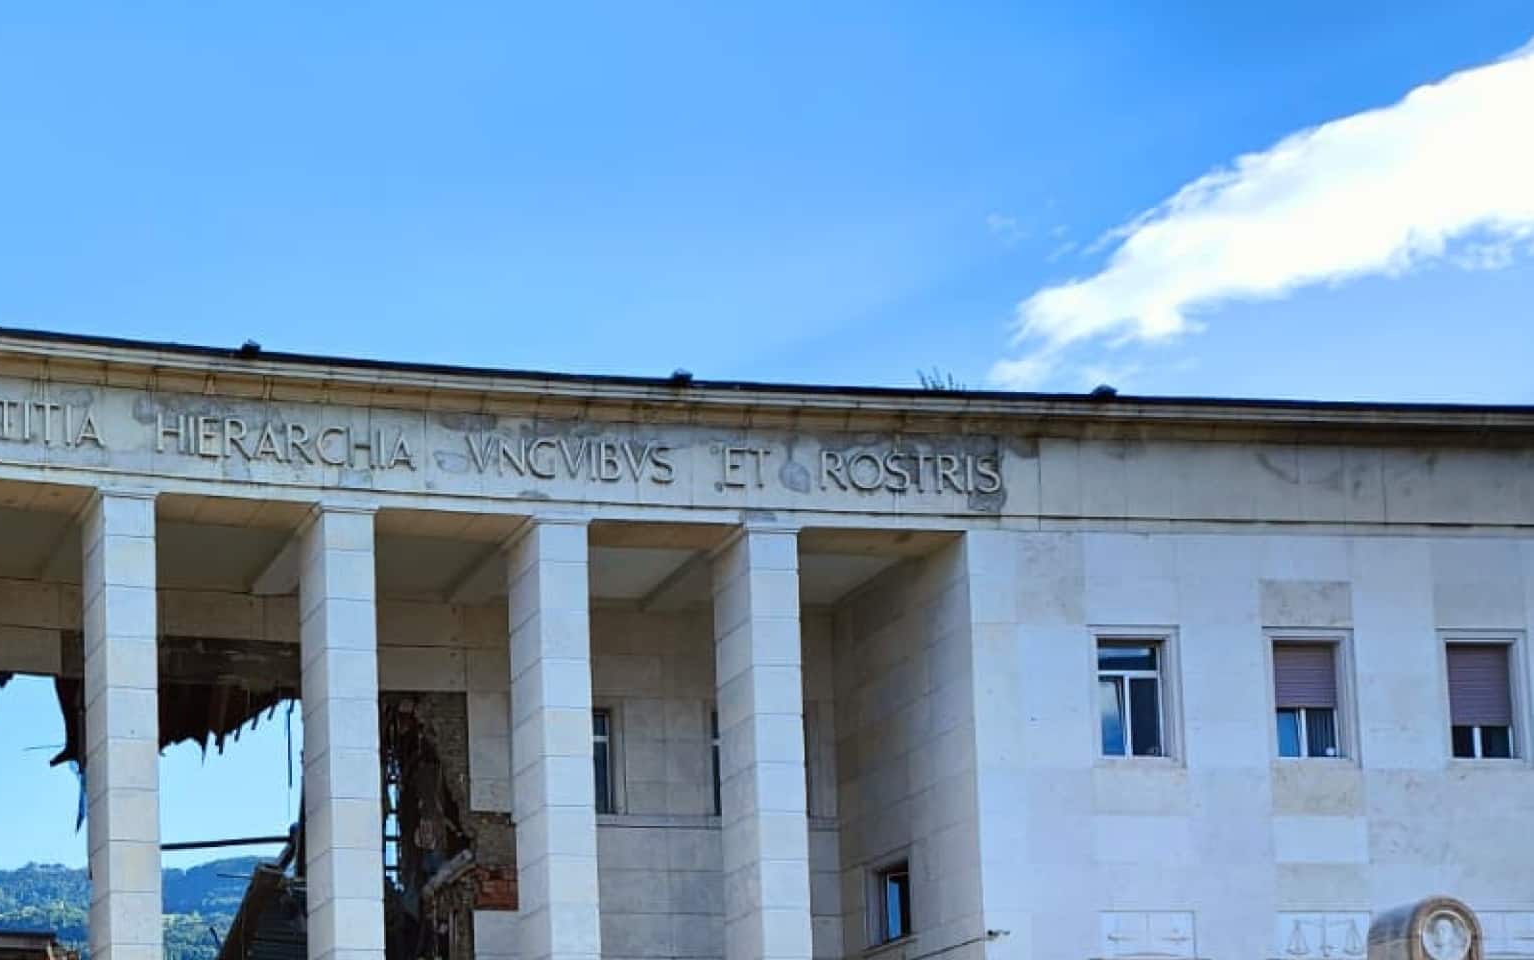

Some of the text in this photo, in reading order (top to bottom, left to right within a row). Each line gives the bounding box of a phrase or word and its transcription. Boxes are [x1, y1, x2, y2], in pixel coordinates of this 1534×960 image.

[156, 412, 417, 471] HIERARCHIA
[722, 447, 770, 489] ET
[819, 448, 1003, 495] ROSTRIS
